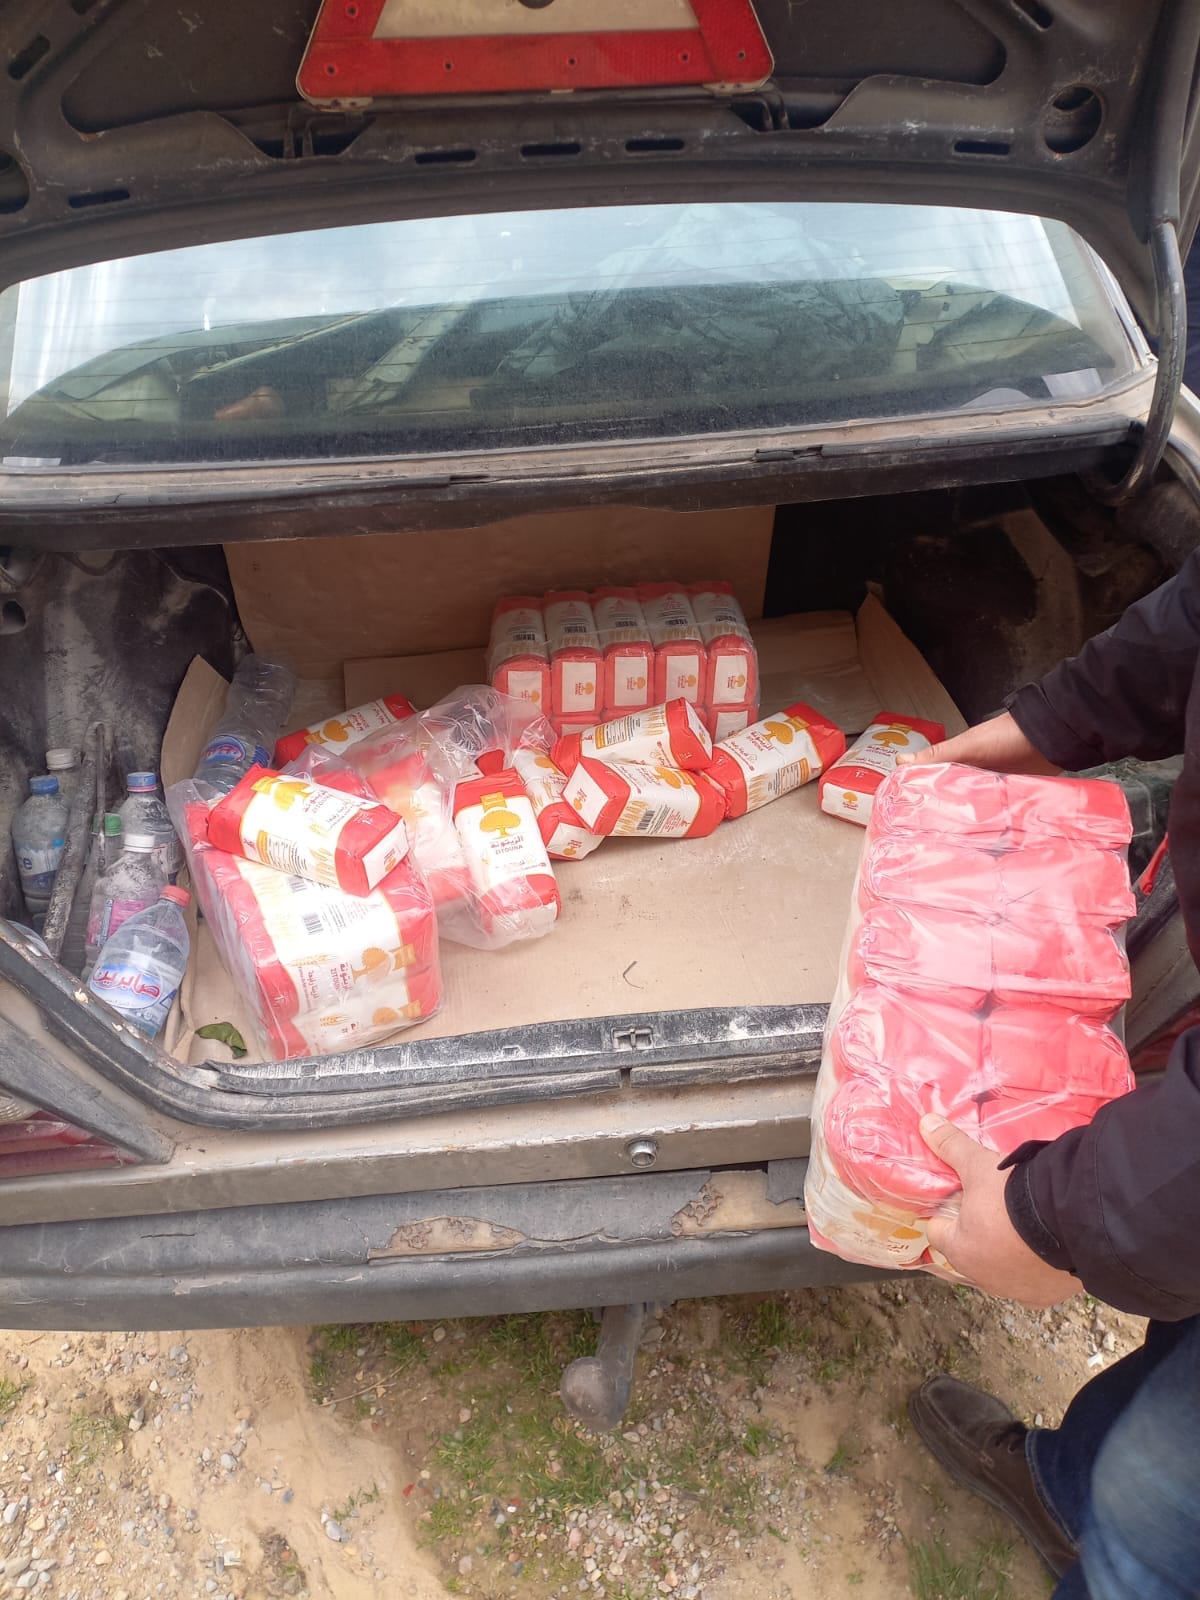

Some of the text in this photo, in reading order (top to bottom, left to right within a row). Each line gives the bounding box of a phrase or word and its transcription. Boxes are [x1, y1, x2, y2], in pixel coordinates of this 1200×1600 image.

[489, 835, 524, 848] الزيتونة
[495, 844, 523, 855] ZITOUNA
[93, 966, 162, 999] صابرين
